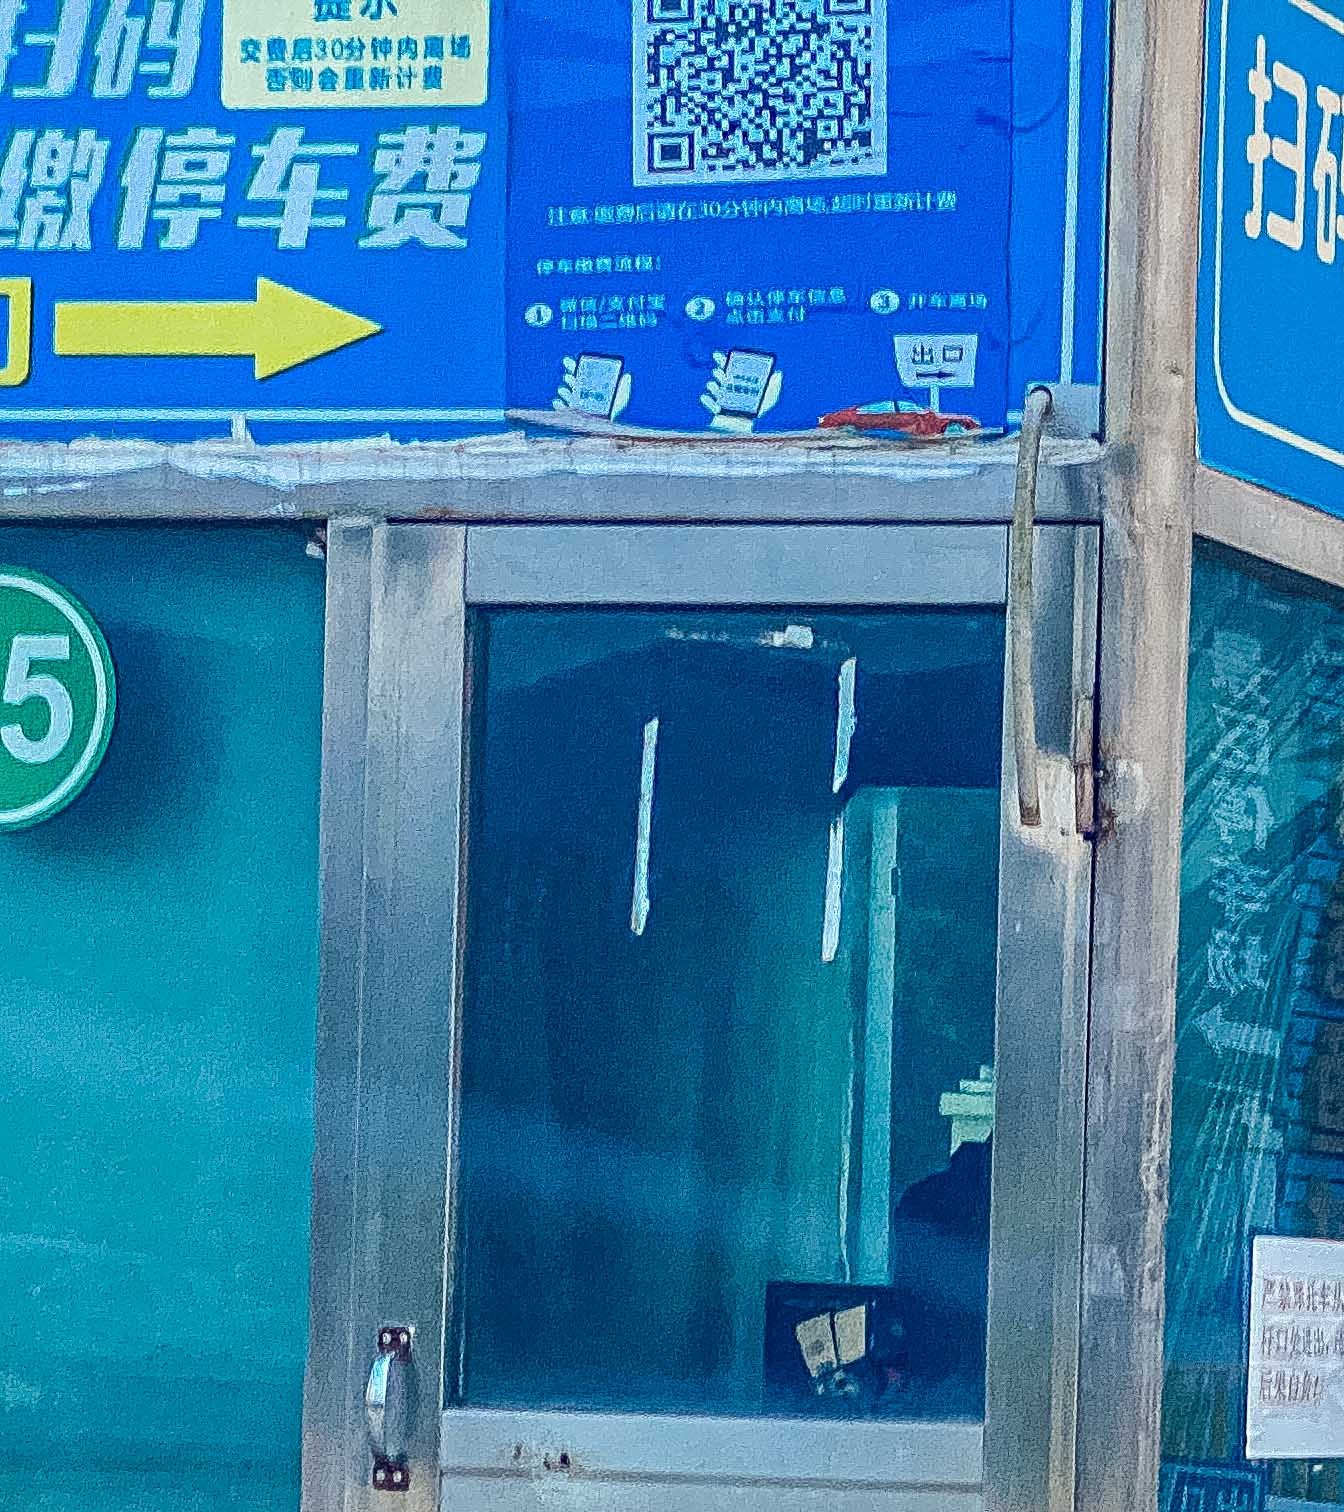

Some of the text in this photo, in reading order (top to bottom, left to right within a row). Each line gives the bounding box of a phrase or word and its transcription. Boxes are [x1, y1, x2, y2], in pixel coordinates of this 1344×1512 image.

[0, 126, 488, 251] 缴停车费
[911, 343, 966, 366] 出口
